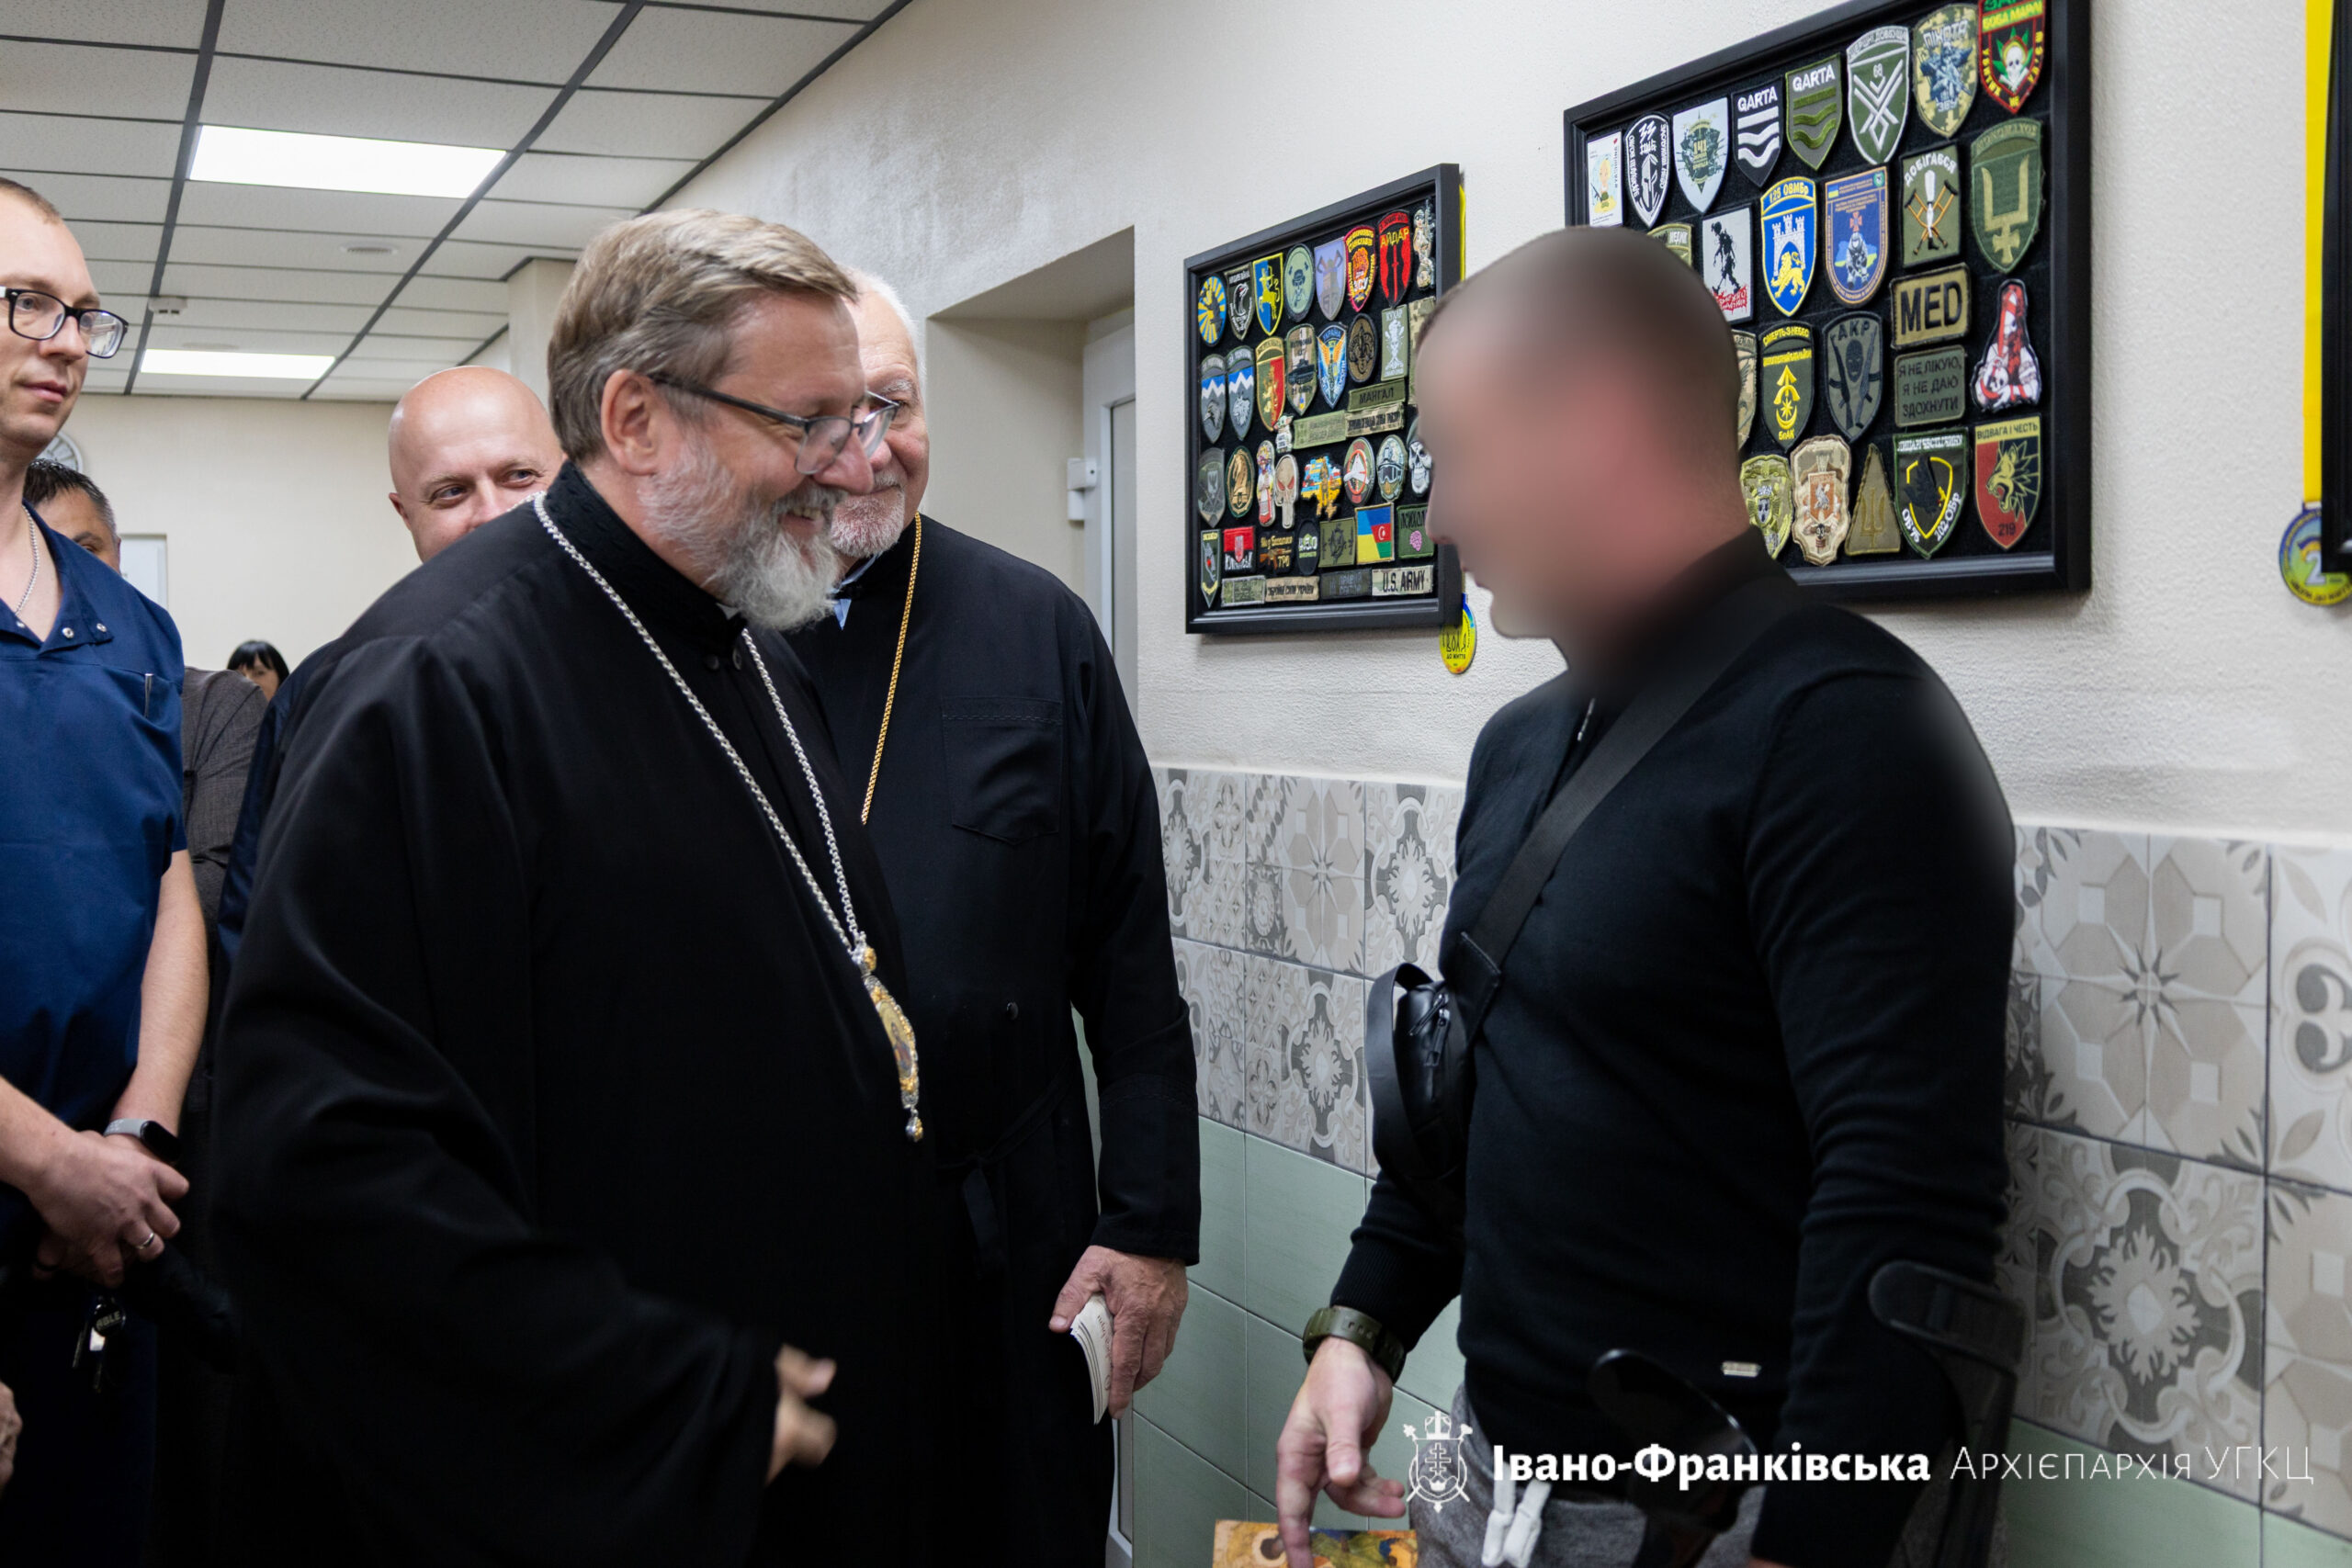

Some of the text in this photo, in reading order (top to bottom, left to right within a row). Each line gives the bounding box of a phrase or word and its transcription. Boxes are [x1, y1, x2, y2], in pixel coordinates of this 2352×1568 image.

[1904, 152, 1958, 187] ДОБІГАВСЯ
[1769, 188, 1781, 204] 125
[1380, 227, 1410, 249] АЙДАР
[1900, 280, 1963, 335] MED
[1898, 355, 1962, 378] Я НЕ ЛІКУЮ,
[1359, 388, 1395, 403] МАНГАЛ
[1903, 377, 1959, 396] Я НЕ ДАЮ
[1902, 397, 1959, 418] ЗДОХНУТИ
[1976, 427, 2008, 440] ВІДВАГА
[2013, 423, 2039, 434] ЧЕСТЬ
[1997, 523, 2017, 536] 219
[1383, 570, 1426, 593] U.S. ARMY
